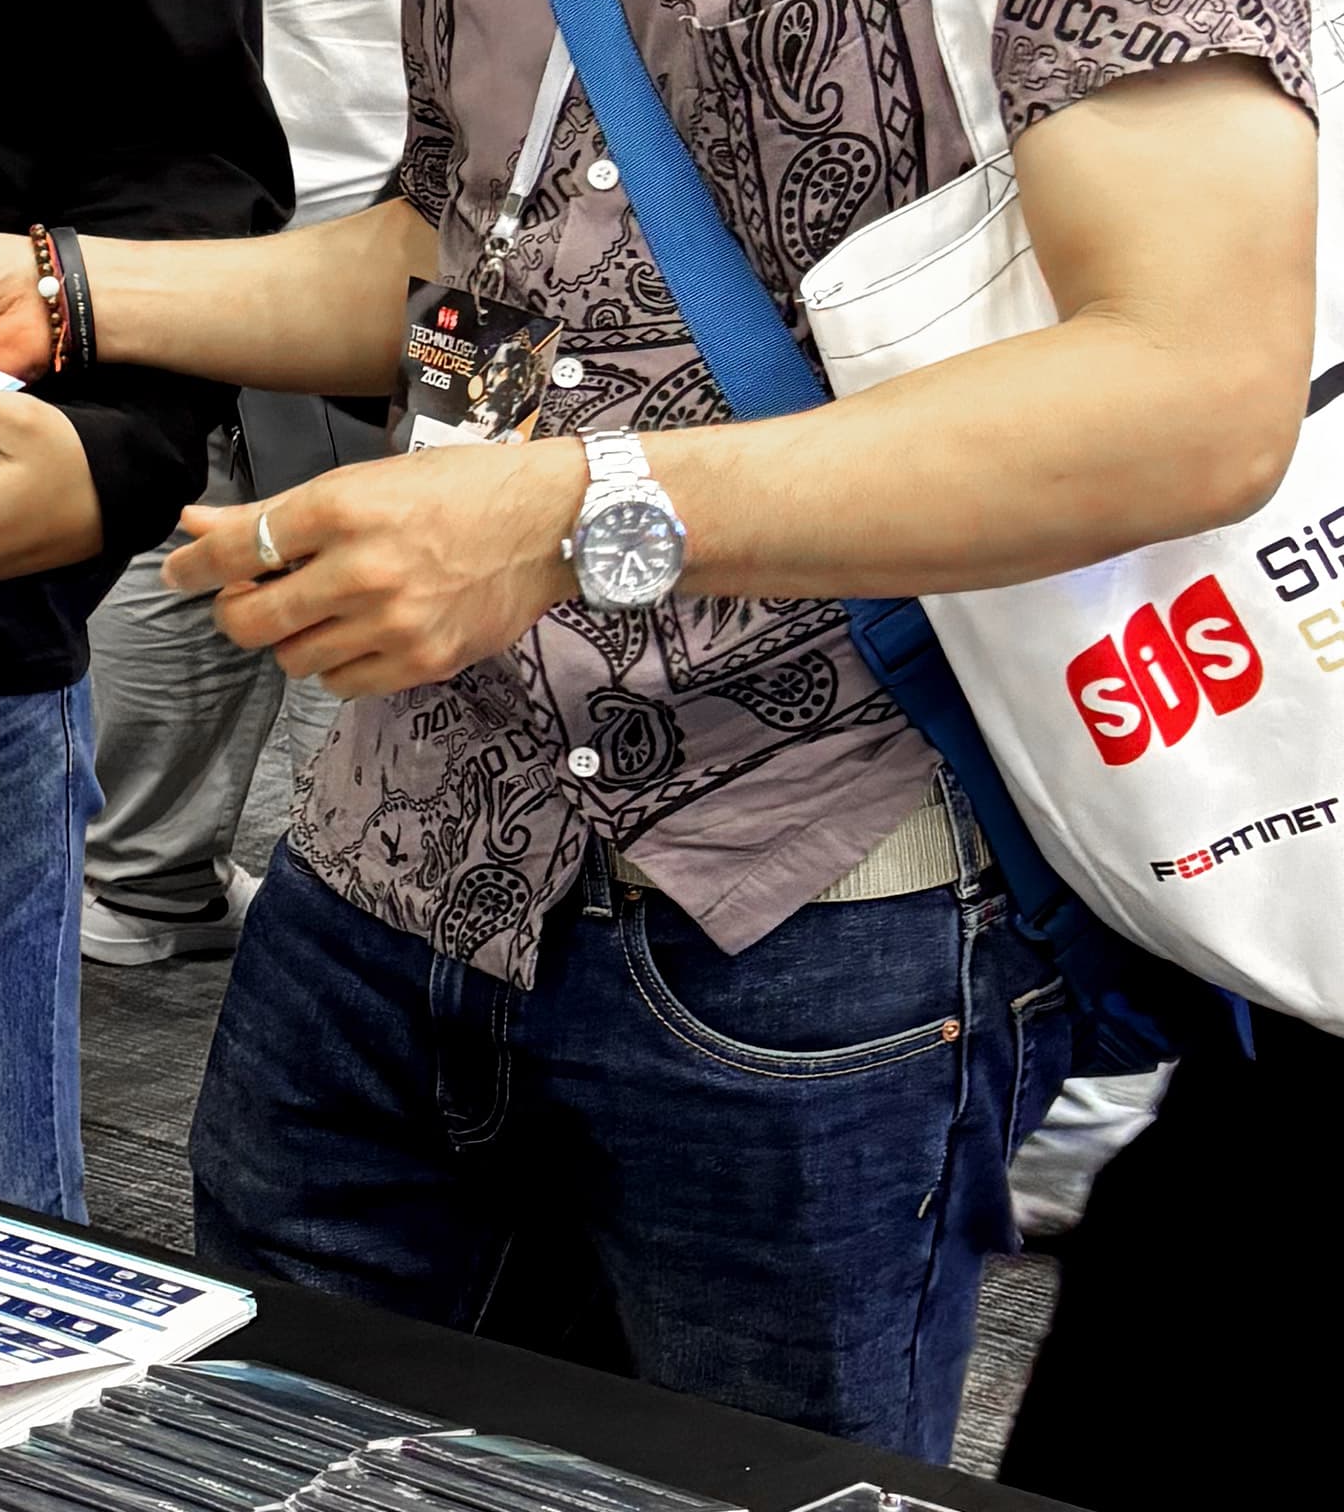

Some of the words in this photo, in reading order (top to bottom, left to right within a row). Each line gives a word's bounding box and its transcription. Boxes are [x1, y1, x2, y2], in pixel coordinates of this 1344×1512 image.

[411, 325, 478, 355] TECHNOLOGY
[408, 341, 475, 378] SHOWCASE
[1149, 797, 1339, 882] FORTINET
